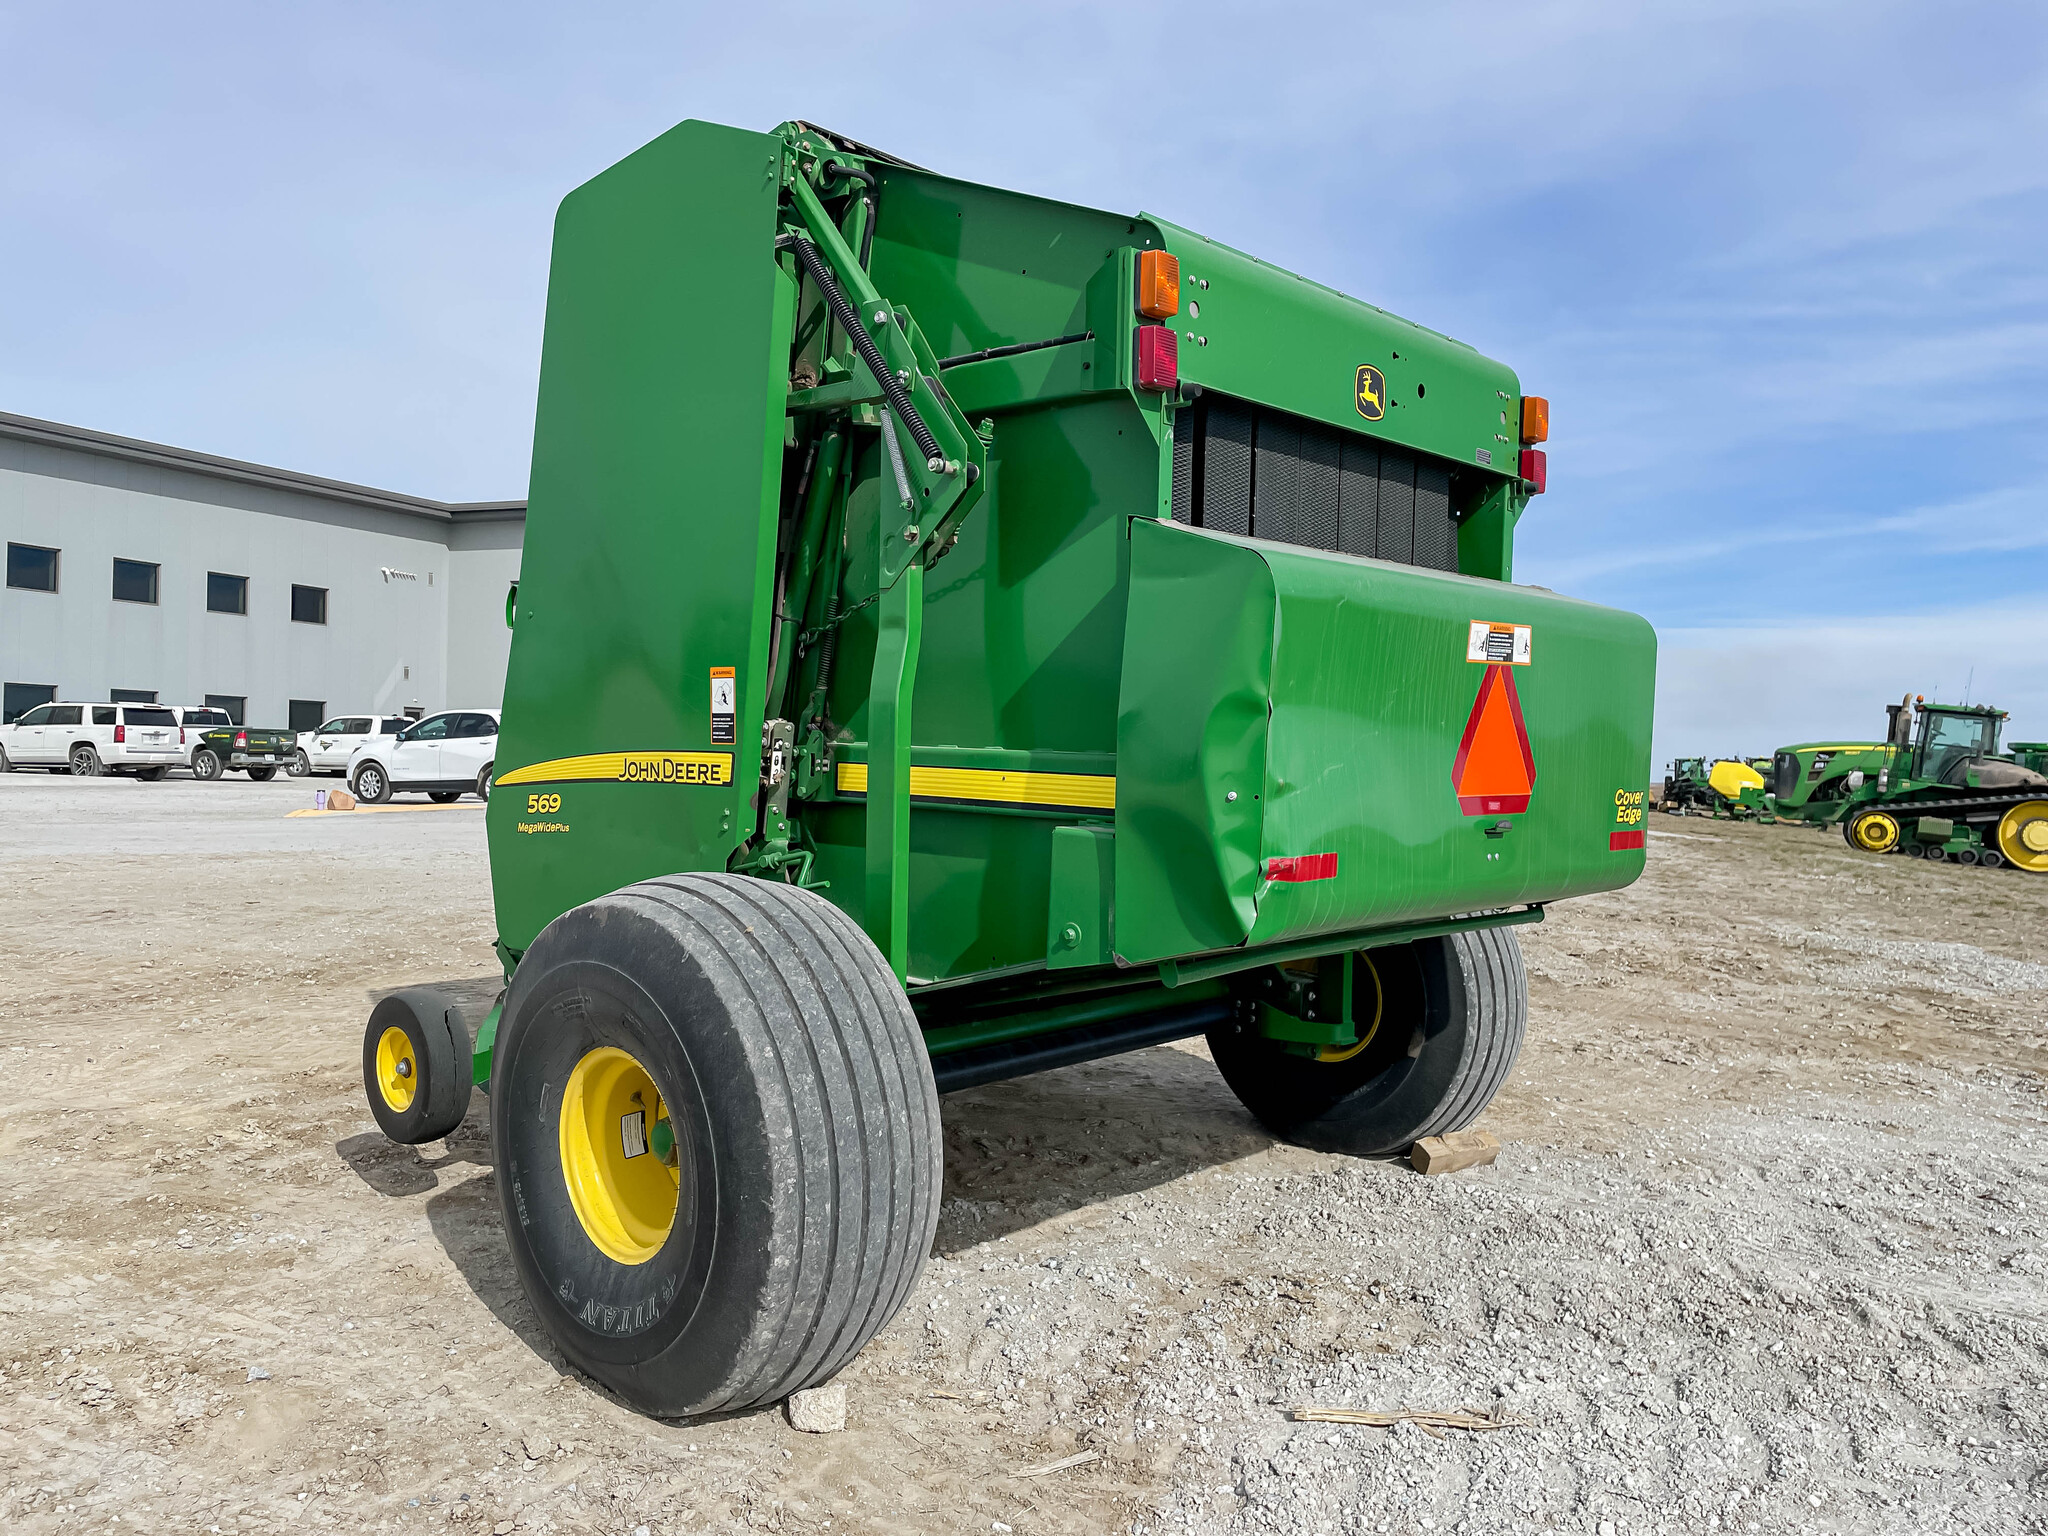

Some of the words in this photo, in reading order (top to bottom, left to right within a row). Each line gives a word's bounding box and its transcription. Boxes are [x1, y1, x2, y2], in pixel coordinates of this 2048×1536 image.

[618, 757, 660, 779] JOHN
[662, 758, 722, 782] DEERE
[527, 793, 562, 814] 569
[1614, 788, 1644, 806] Cover
[1615, 805, 1642, 826] Edge
[517, 822, 570, 835] MegaWidePlus
[578, 1297, 660, 1334] TITAN
